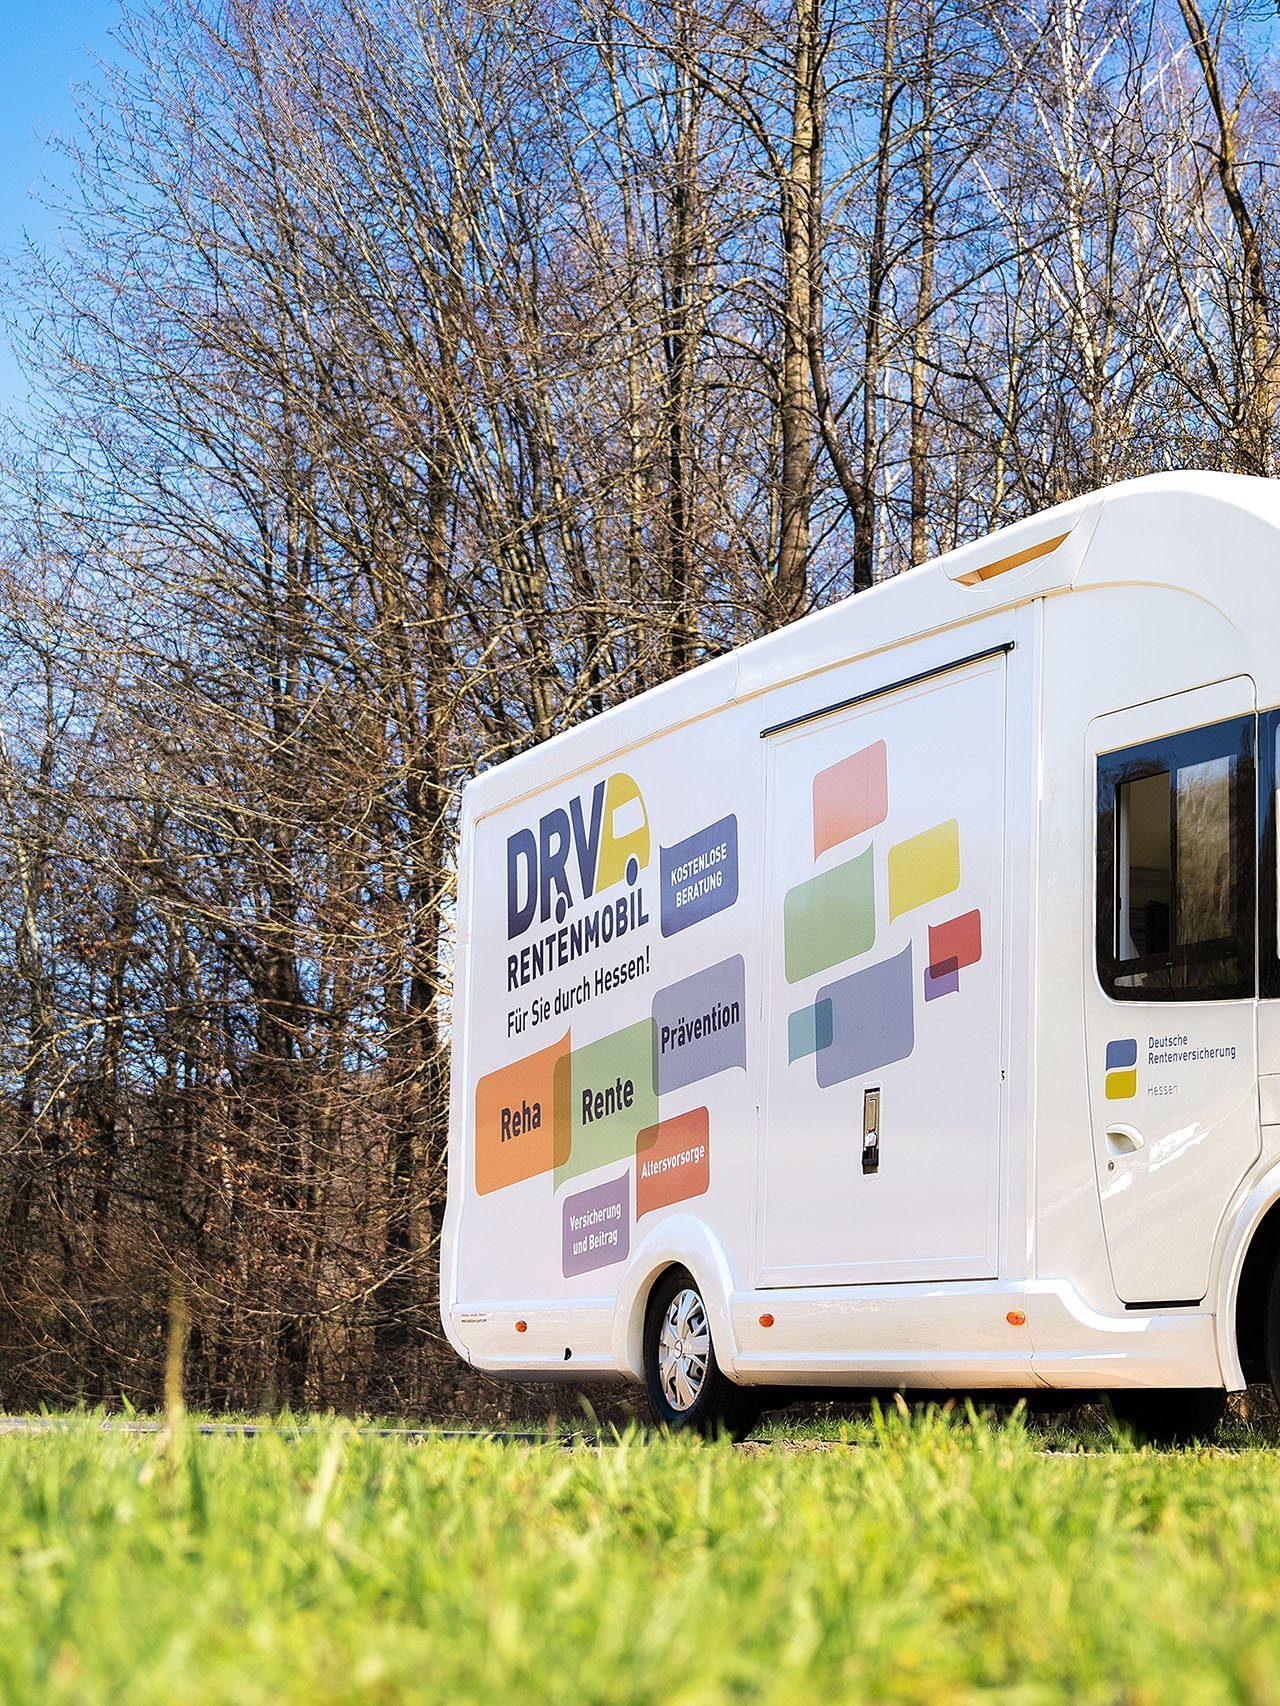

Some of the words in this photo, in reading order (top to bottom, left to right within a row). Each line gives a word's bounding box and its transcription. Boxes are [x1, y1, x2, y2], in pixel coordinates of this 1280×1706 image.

[507, 780, 606, 940] DRV
[670, 843, 727, 886] KOSTENLOSE
[676, 870, 722, 908] BERATUNG
[507, 887, 649, 992] RENTENMOBIL
[507, 1008, 529, 1037] Für
[532, 997, 550, 1027] Sie
[555, 976, 590, 1015] durch
[595, 945, 650, 996] Hessen!
[661, 1001, 740, 1053] Prävention
[1148, 1034, 1188, 1049] Deutsche
[1148, 1046, 1236, 1064] Rentenversicherung
[582, 1077, 634, 1125] Rente
[1148, 1083, 1178, 1096] Hessen
[501, 1100, 541, 1142] Reha
[641, 1144, 705, 1179] Altersvorsorge
[569, 1202, 621, 1231] Versicherung
[572, 1238, 588, 1256] und
[589, 1229, 618, 1249] Beitrag
